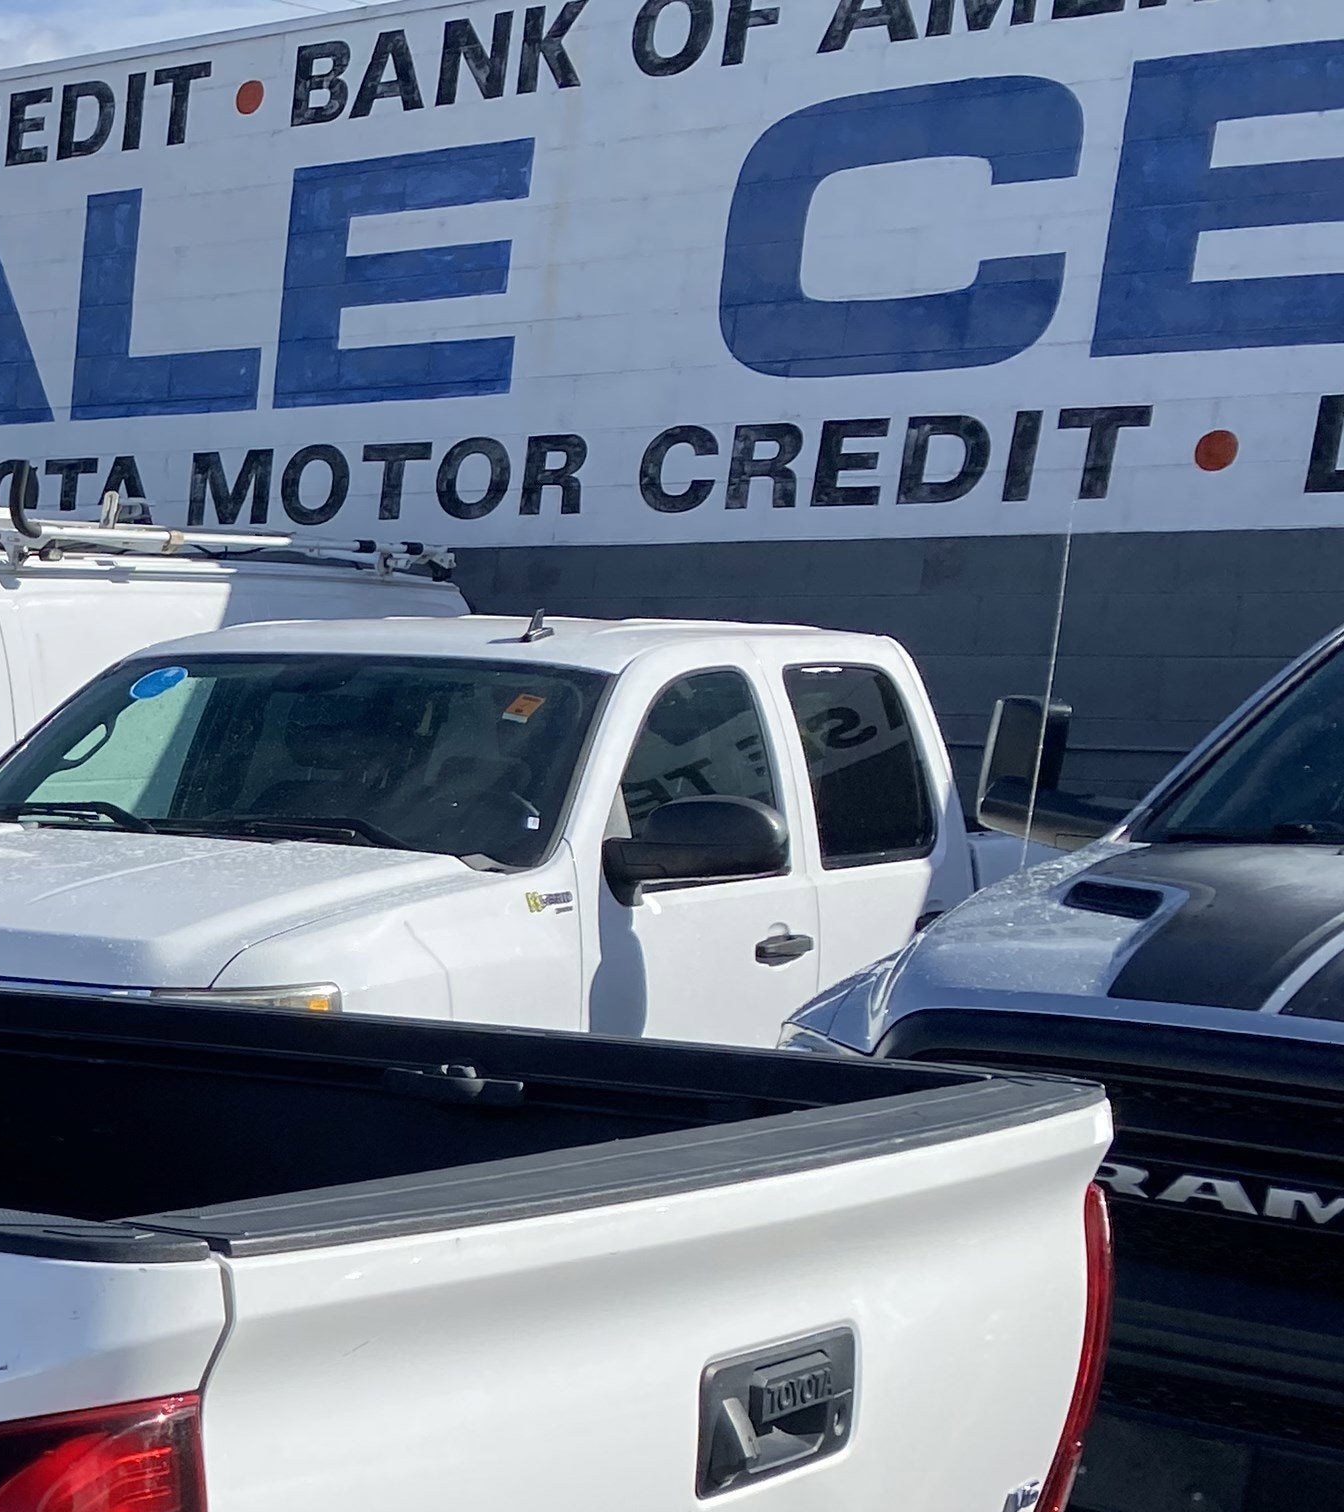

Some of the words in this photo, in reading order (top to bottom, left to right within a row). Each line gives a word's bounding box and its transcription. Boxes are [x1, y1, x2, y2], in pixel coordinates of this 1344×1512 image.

[290, 0, 589, 127] BANK
[632, 0, 781, 77] OF
[718, 38, 1344, 379] CE
[186, 433, 588, 526] MOTOR
[638, 404, 1153, 514] CREDIT
[765, 1366, 832, 1414] TOYOTA
